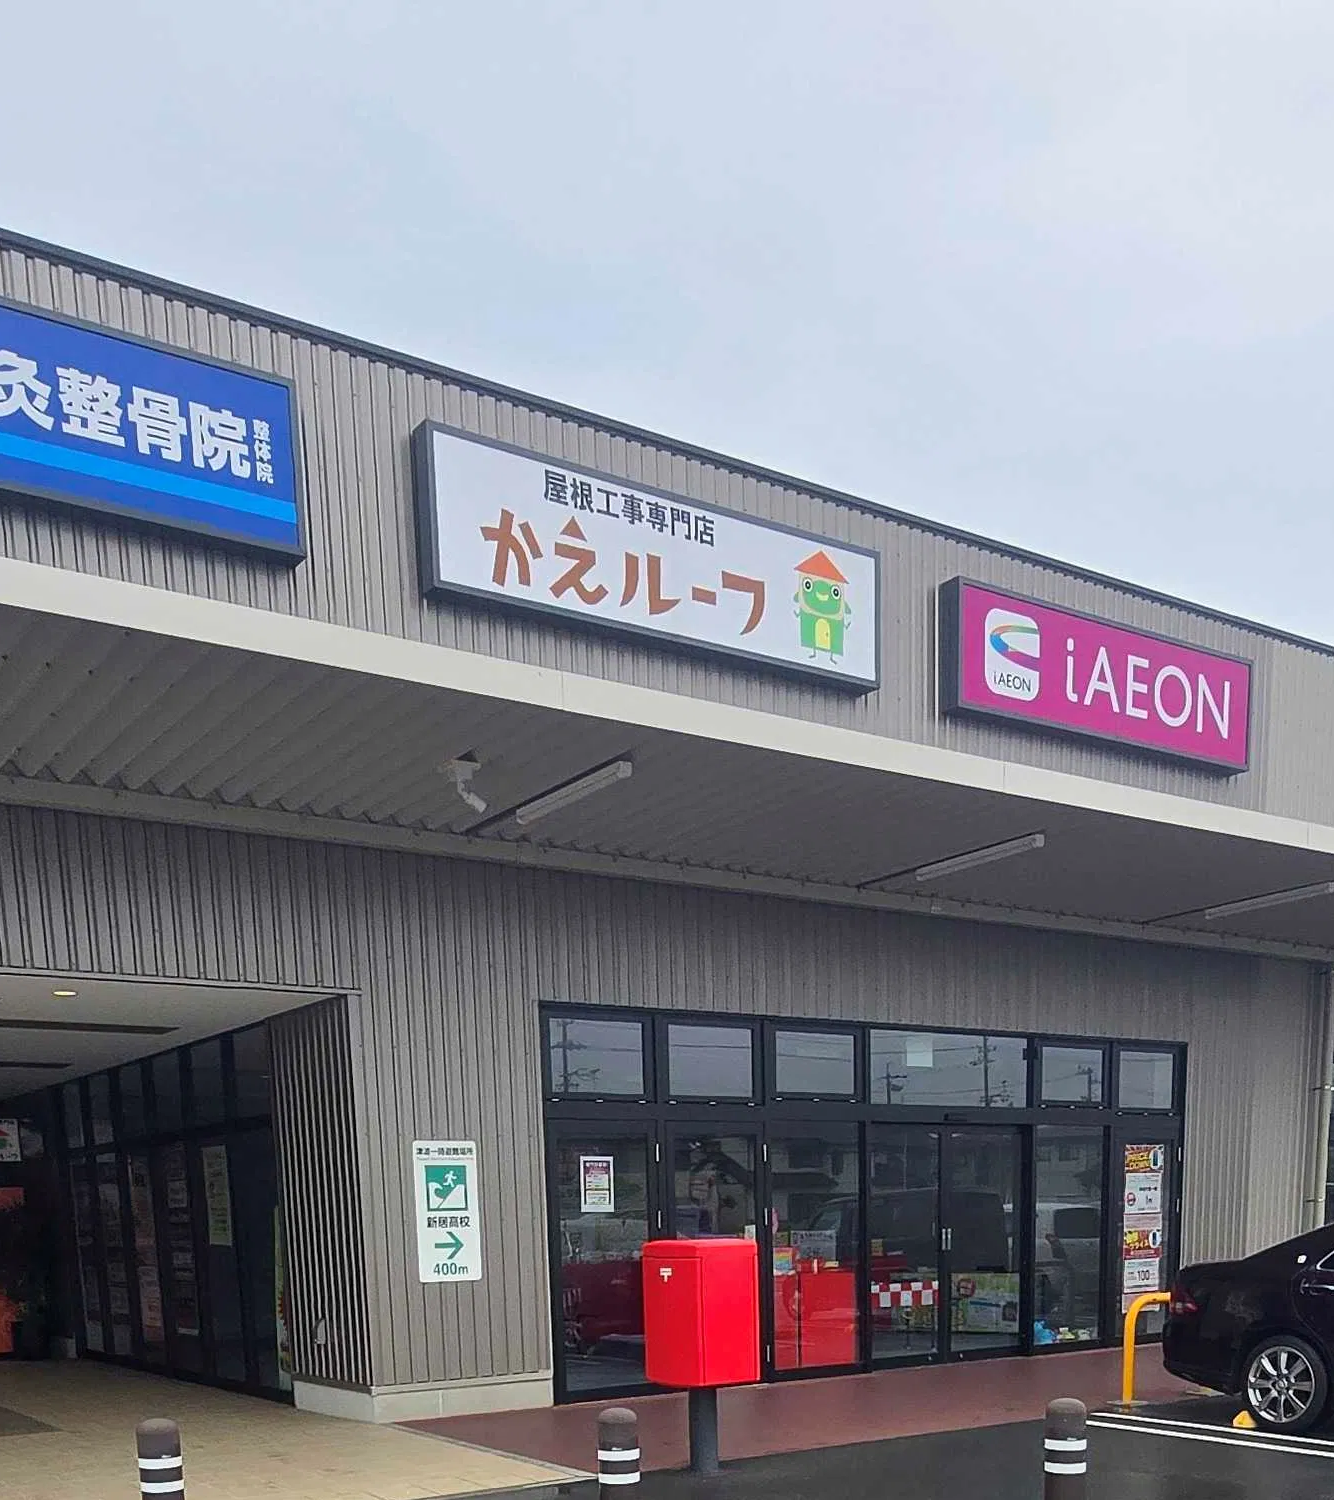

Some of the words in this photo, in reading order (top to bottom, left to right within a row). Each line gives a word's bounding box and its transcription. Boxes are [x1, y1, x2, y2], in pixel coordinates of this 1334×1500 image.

[542, 466, 717, 548] 屋根工事専門店
[480, 507, 767, 637] かえルーフ
[1066, 637, 1231, 740] iAEON
[426, 1216, 471, 1229] 新居高校
[433, 1262, 469, 1276] 400m
